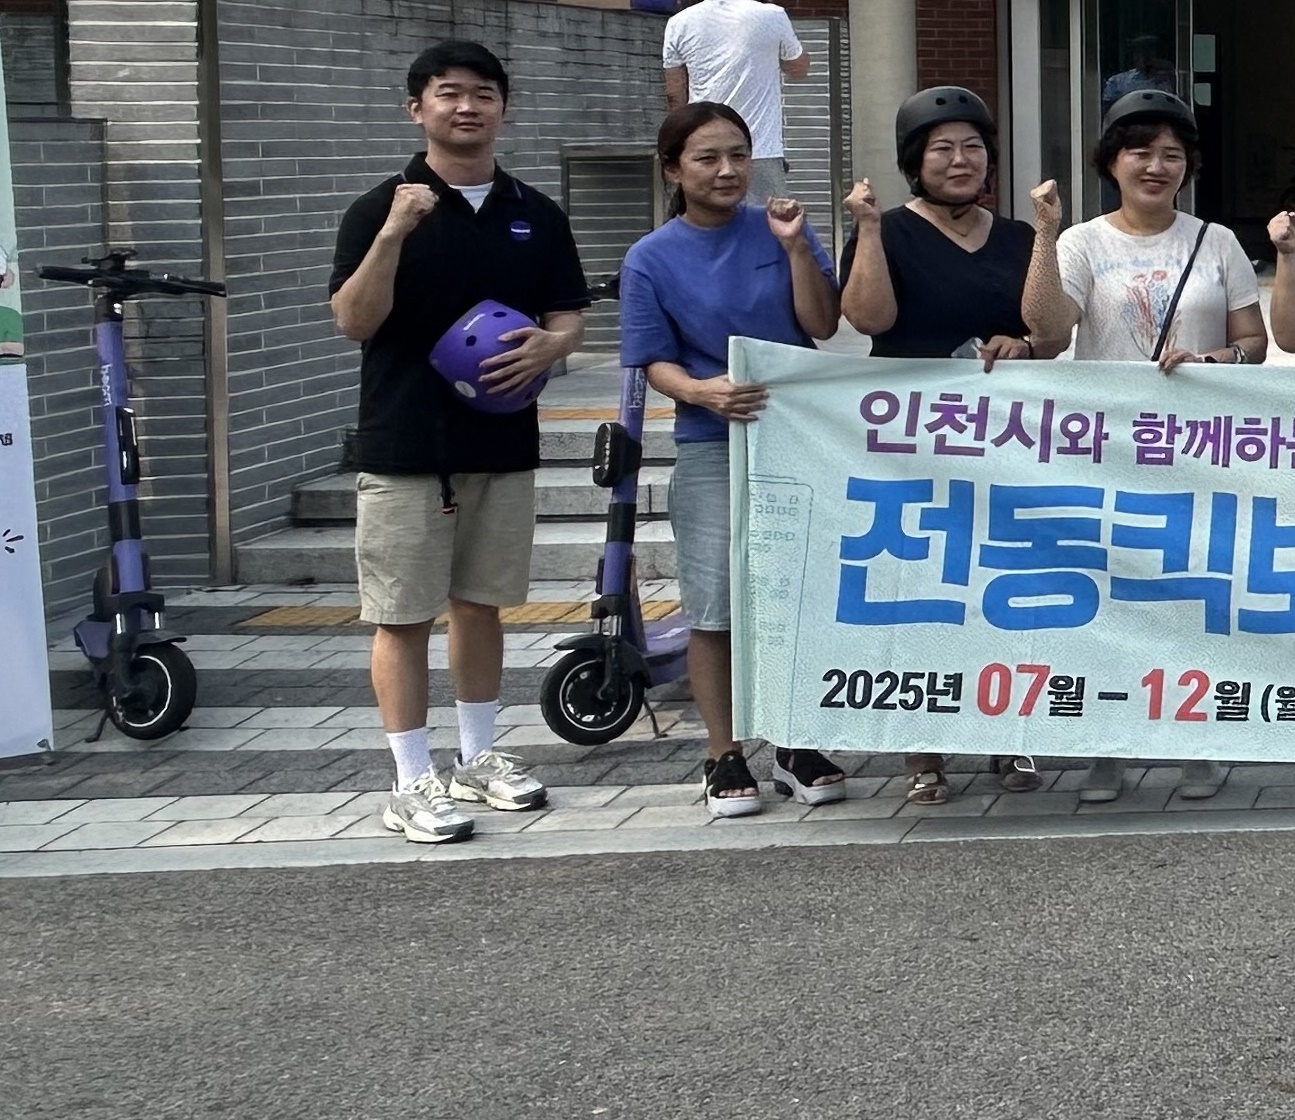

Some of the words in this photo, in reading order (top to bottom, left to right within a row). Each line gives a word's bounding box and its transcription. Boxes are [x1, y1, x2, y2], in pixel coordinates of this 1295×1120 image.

[858, 388, 1110, 465] 인천시와
[820, 668, 963, 716] 2025년
[976, 662, 1086, 718] 07월
[1140, 668, 1252, 724] 12월
